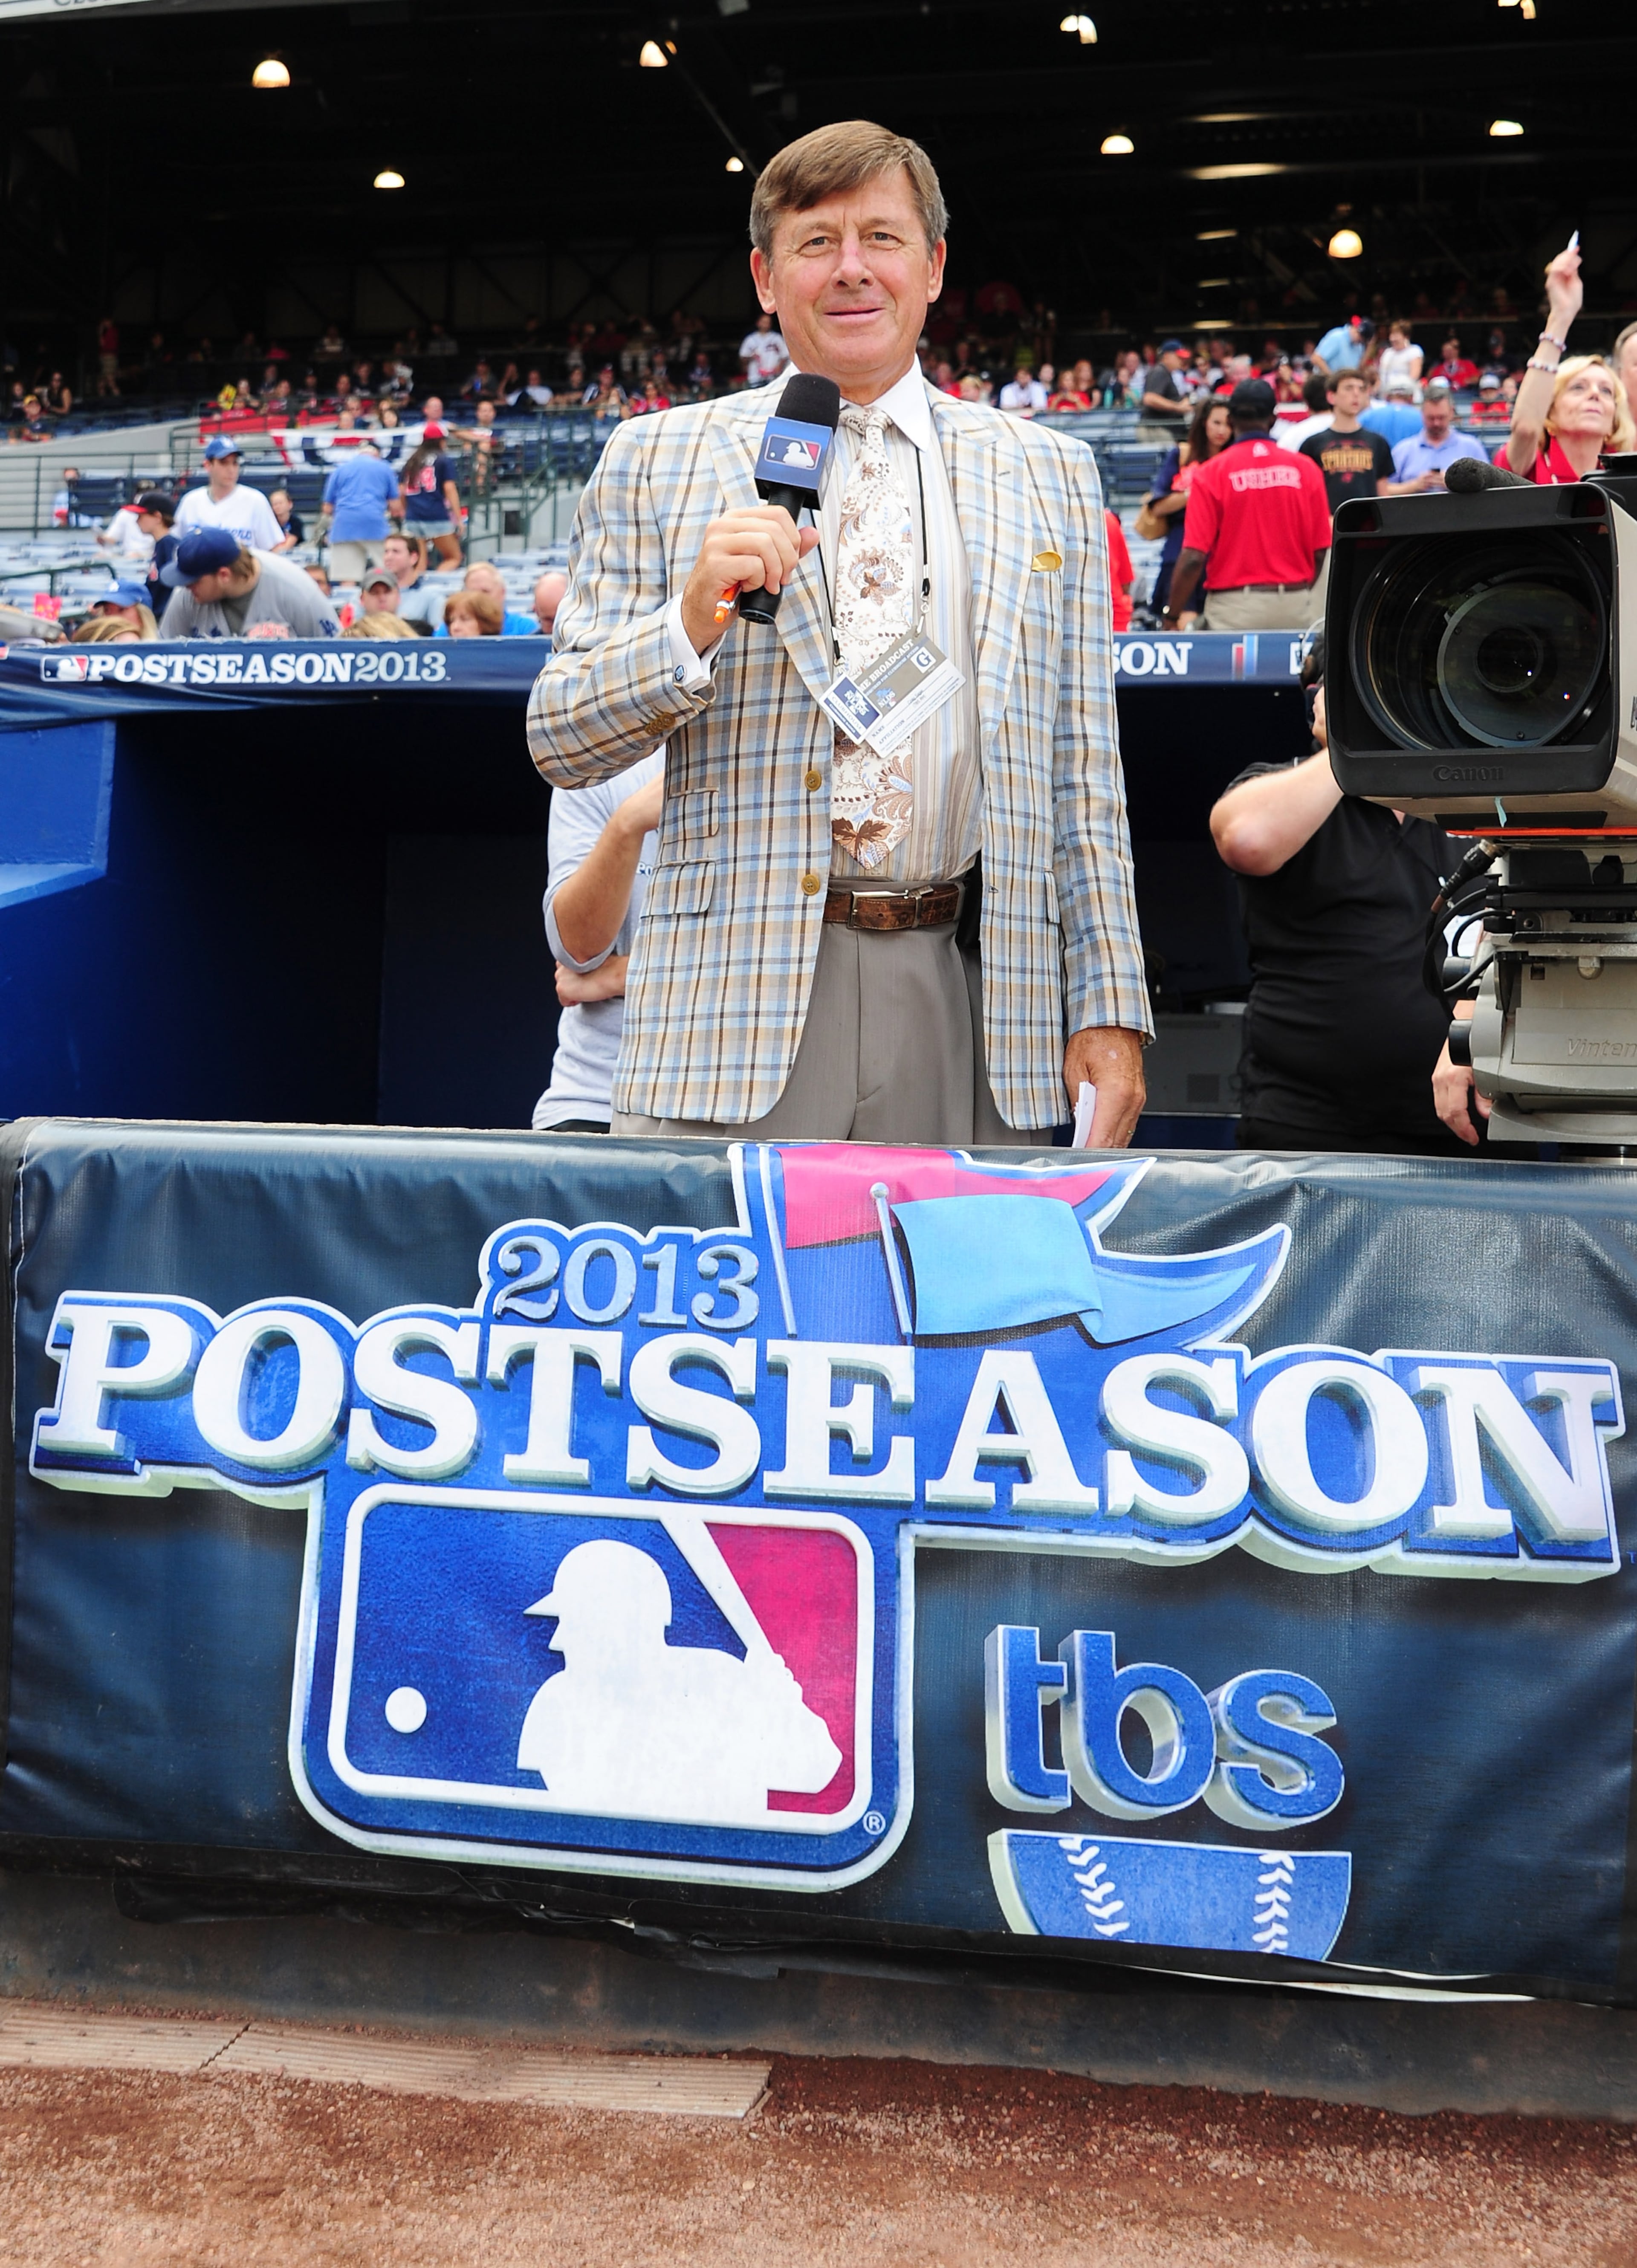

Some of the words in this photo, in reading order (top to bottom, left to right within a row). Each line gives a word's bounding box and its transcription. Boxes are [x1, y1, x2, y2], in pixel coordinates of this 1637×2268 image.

[869, 639, 915, 682] BROADCAST
[915, 651, 932, 668] G
[877, 690, 896, 708] NLDS
[872, 725, 885, 737] NAME
[878, 719, 905, 744] AFFILIATION
[1433, 765, 1504, 781] Canon
[1568, 1039, 1637, 1057] Vinten
[495, 1235, 760, 1331] 2013
[38, 1303, 1614, 1541] POSTSEASON
[985, 1624, 1345, 1831] tbs
